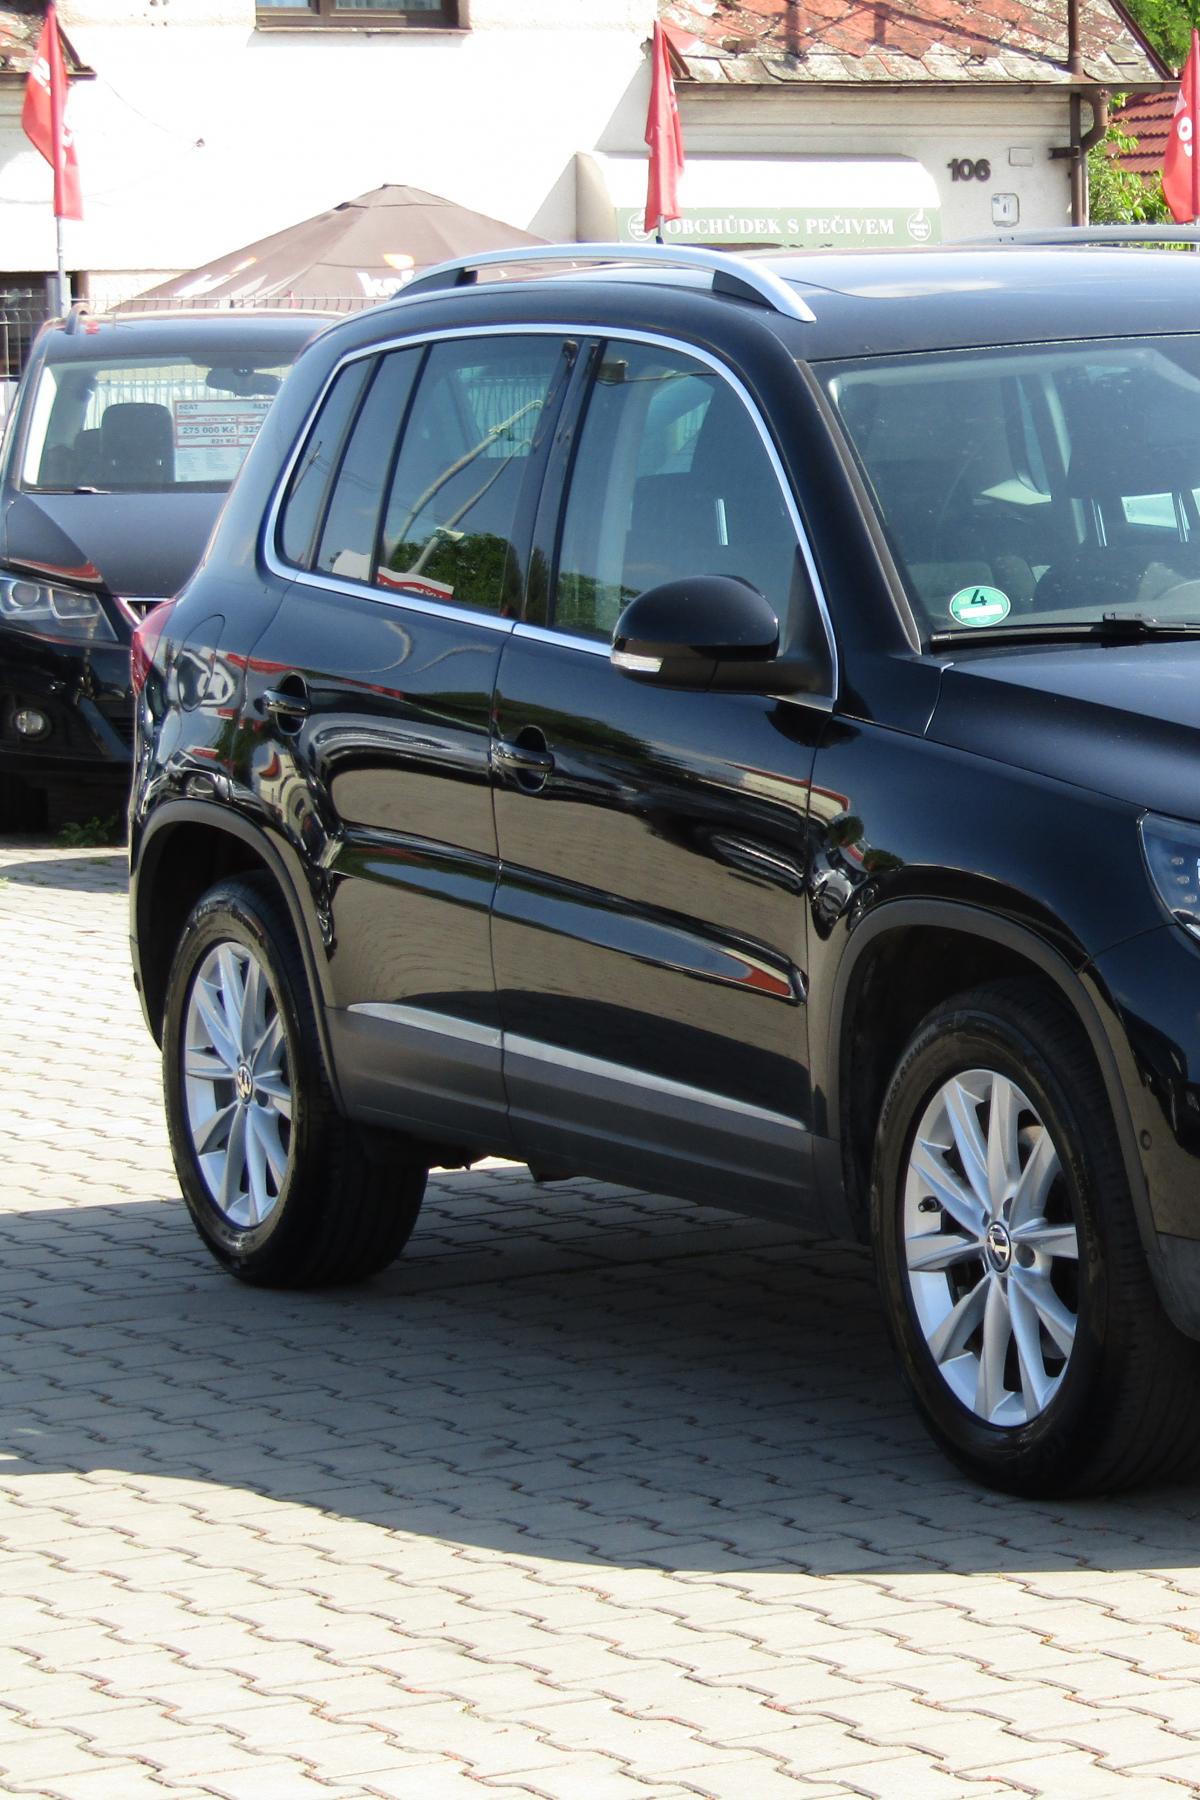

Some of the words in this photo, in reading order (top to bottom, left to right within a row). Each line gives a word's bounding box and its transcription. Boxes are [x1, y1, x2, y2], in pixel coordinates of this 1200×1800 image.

[947, 158, 991, 182] 106
[665, 215, 781, 235] OBCHŮDEK
[787, 218, 800, 235] S
[805, 215, 895, 235] PEČIVEM
[183, 426, 200, 434] 275
[202, 426, 220, 434] 000
[970, 589, 987, 606] 4
